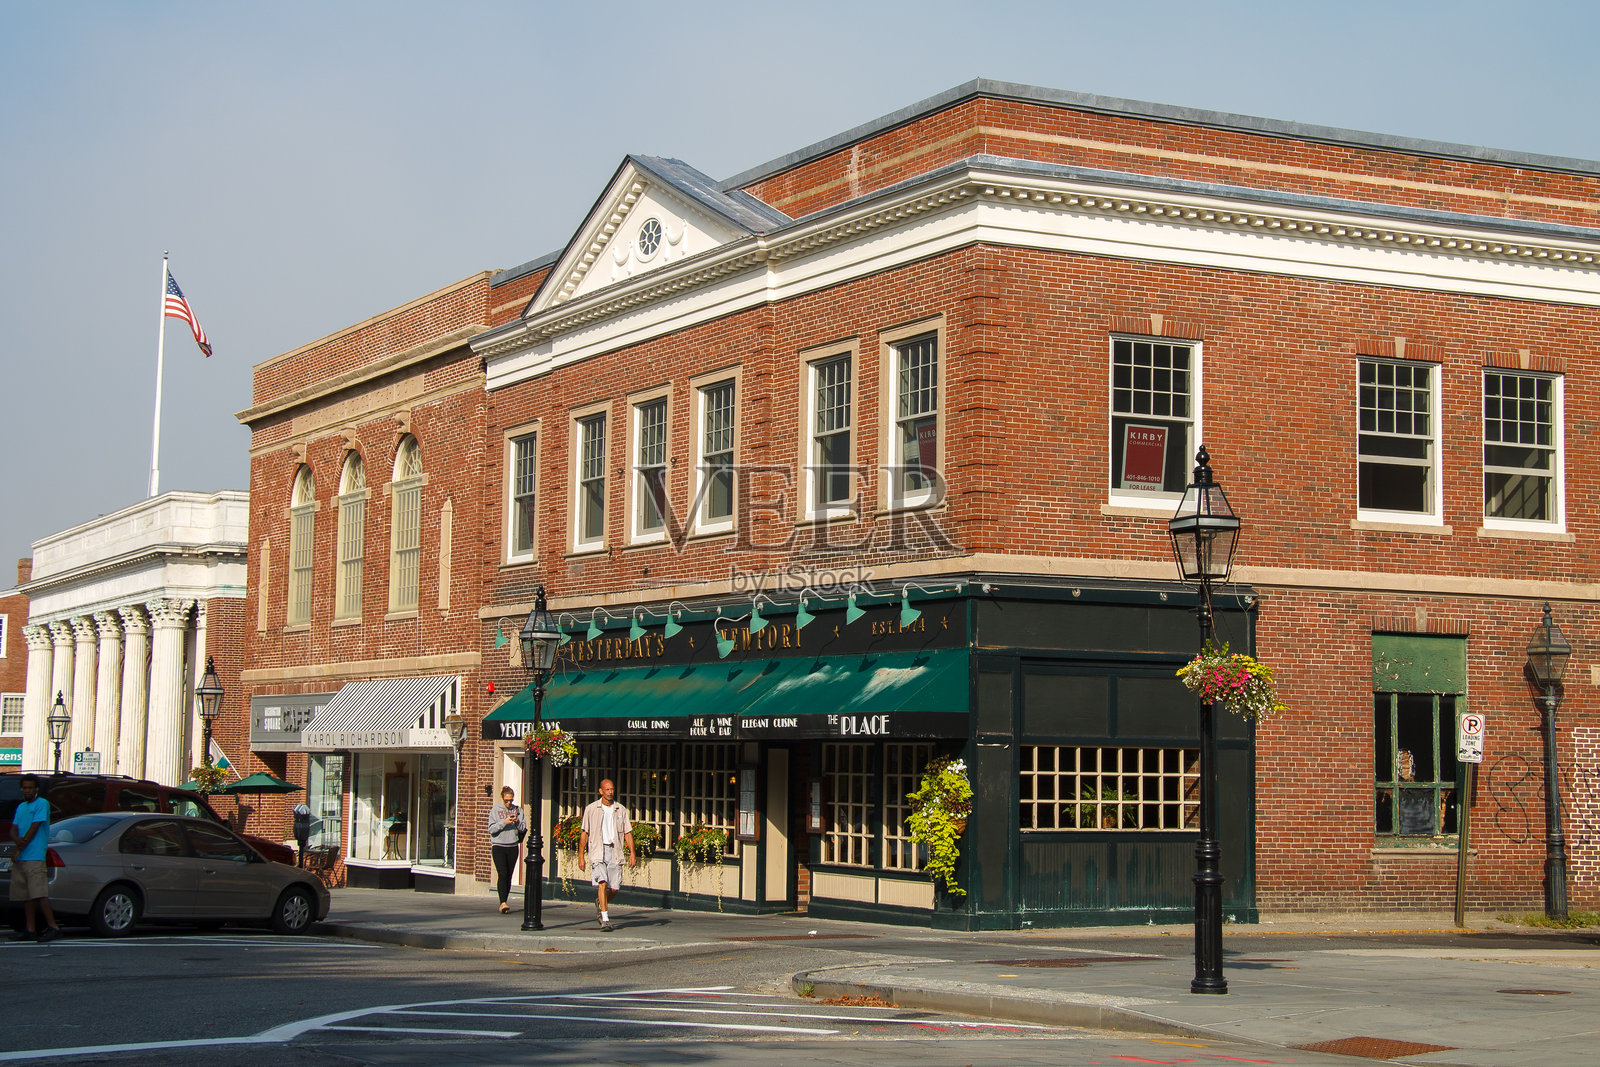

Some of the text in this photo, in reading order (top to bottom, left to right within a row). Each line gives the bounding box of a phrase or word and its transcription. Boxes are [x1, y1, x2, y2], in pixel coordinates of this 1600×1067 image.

[920, 429, 936, 438] KIRB
[1130, 432, 1163, 441] KIRBY
[1126, 474, 1161, 482] 401-846-1010
[872, 620, 895, 635] EST.
[570, 632, 664, 662] YESTERDAY'S
[627, 719, 670, 729] CASUAL DINING
[692, 718, 705, 727] ALE
[709, 719, 716, 734] &
[716, 717, 733, 727] WINE
[741, 717, 798, 729] ELEGANT CUISINE
[827, 714, 890, 735] THE PLACE
[500, 721, 560, 738] YESTERY'S
[690, 727, 708, 736] HOUSE
[718, 727, 732, 736] BAR
[307, 731, 404, 746] KAROL RICHARDSON
[75, 753, 82, 761] 3
